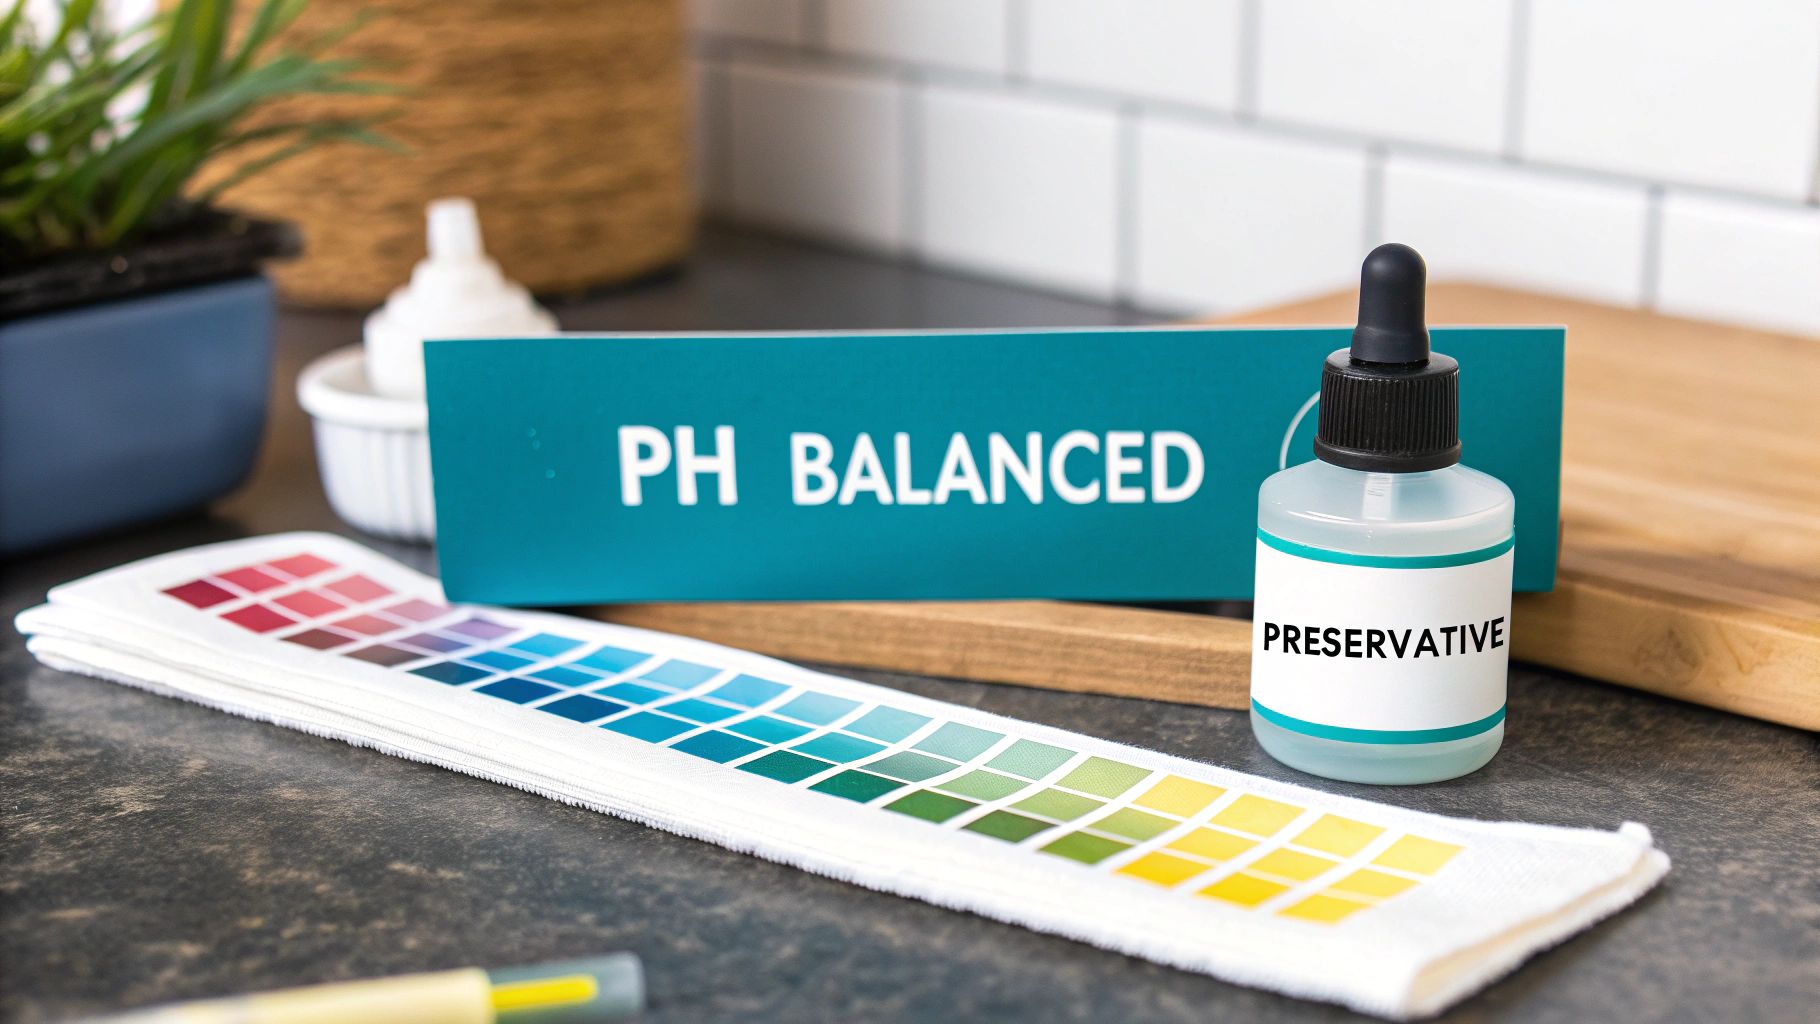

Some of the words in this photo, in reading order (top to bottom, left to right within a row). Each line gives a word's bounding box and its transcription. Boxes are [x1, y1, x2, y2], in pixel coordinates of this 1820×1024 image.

[619, 425, 738, 506] PH
[791, 430, 1204, 505] BALANCED
[1263, 616, 1505, 659] PRESERVATIVE
